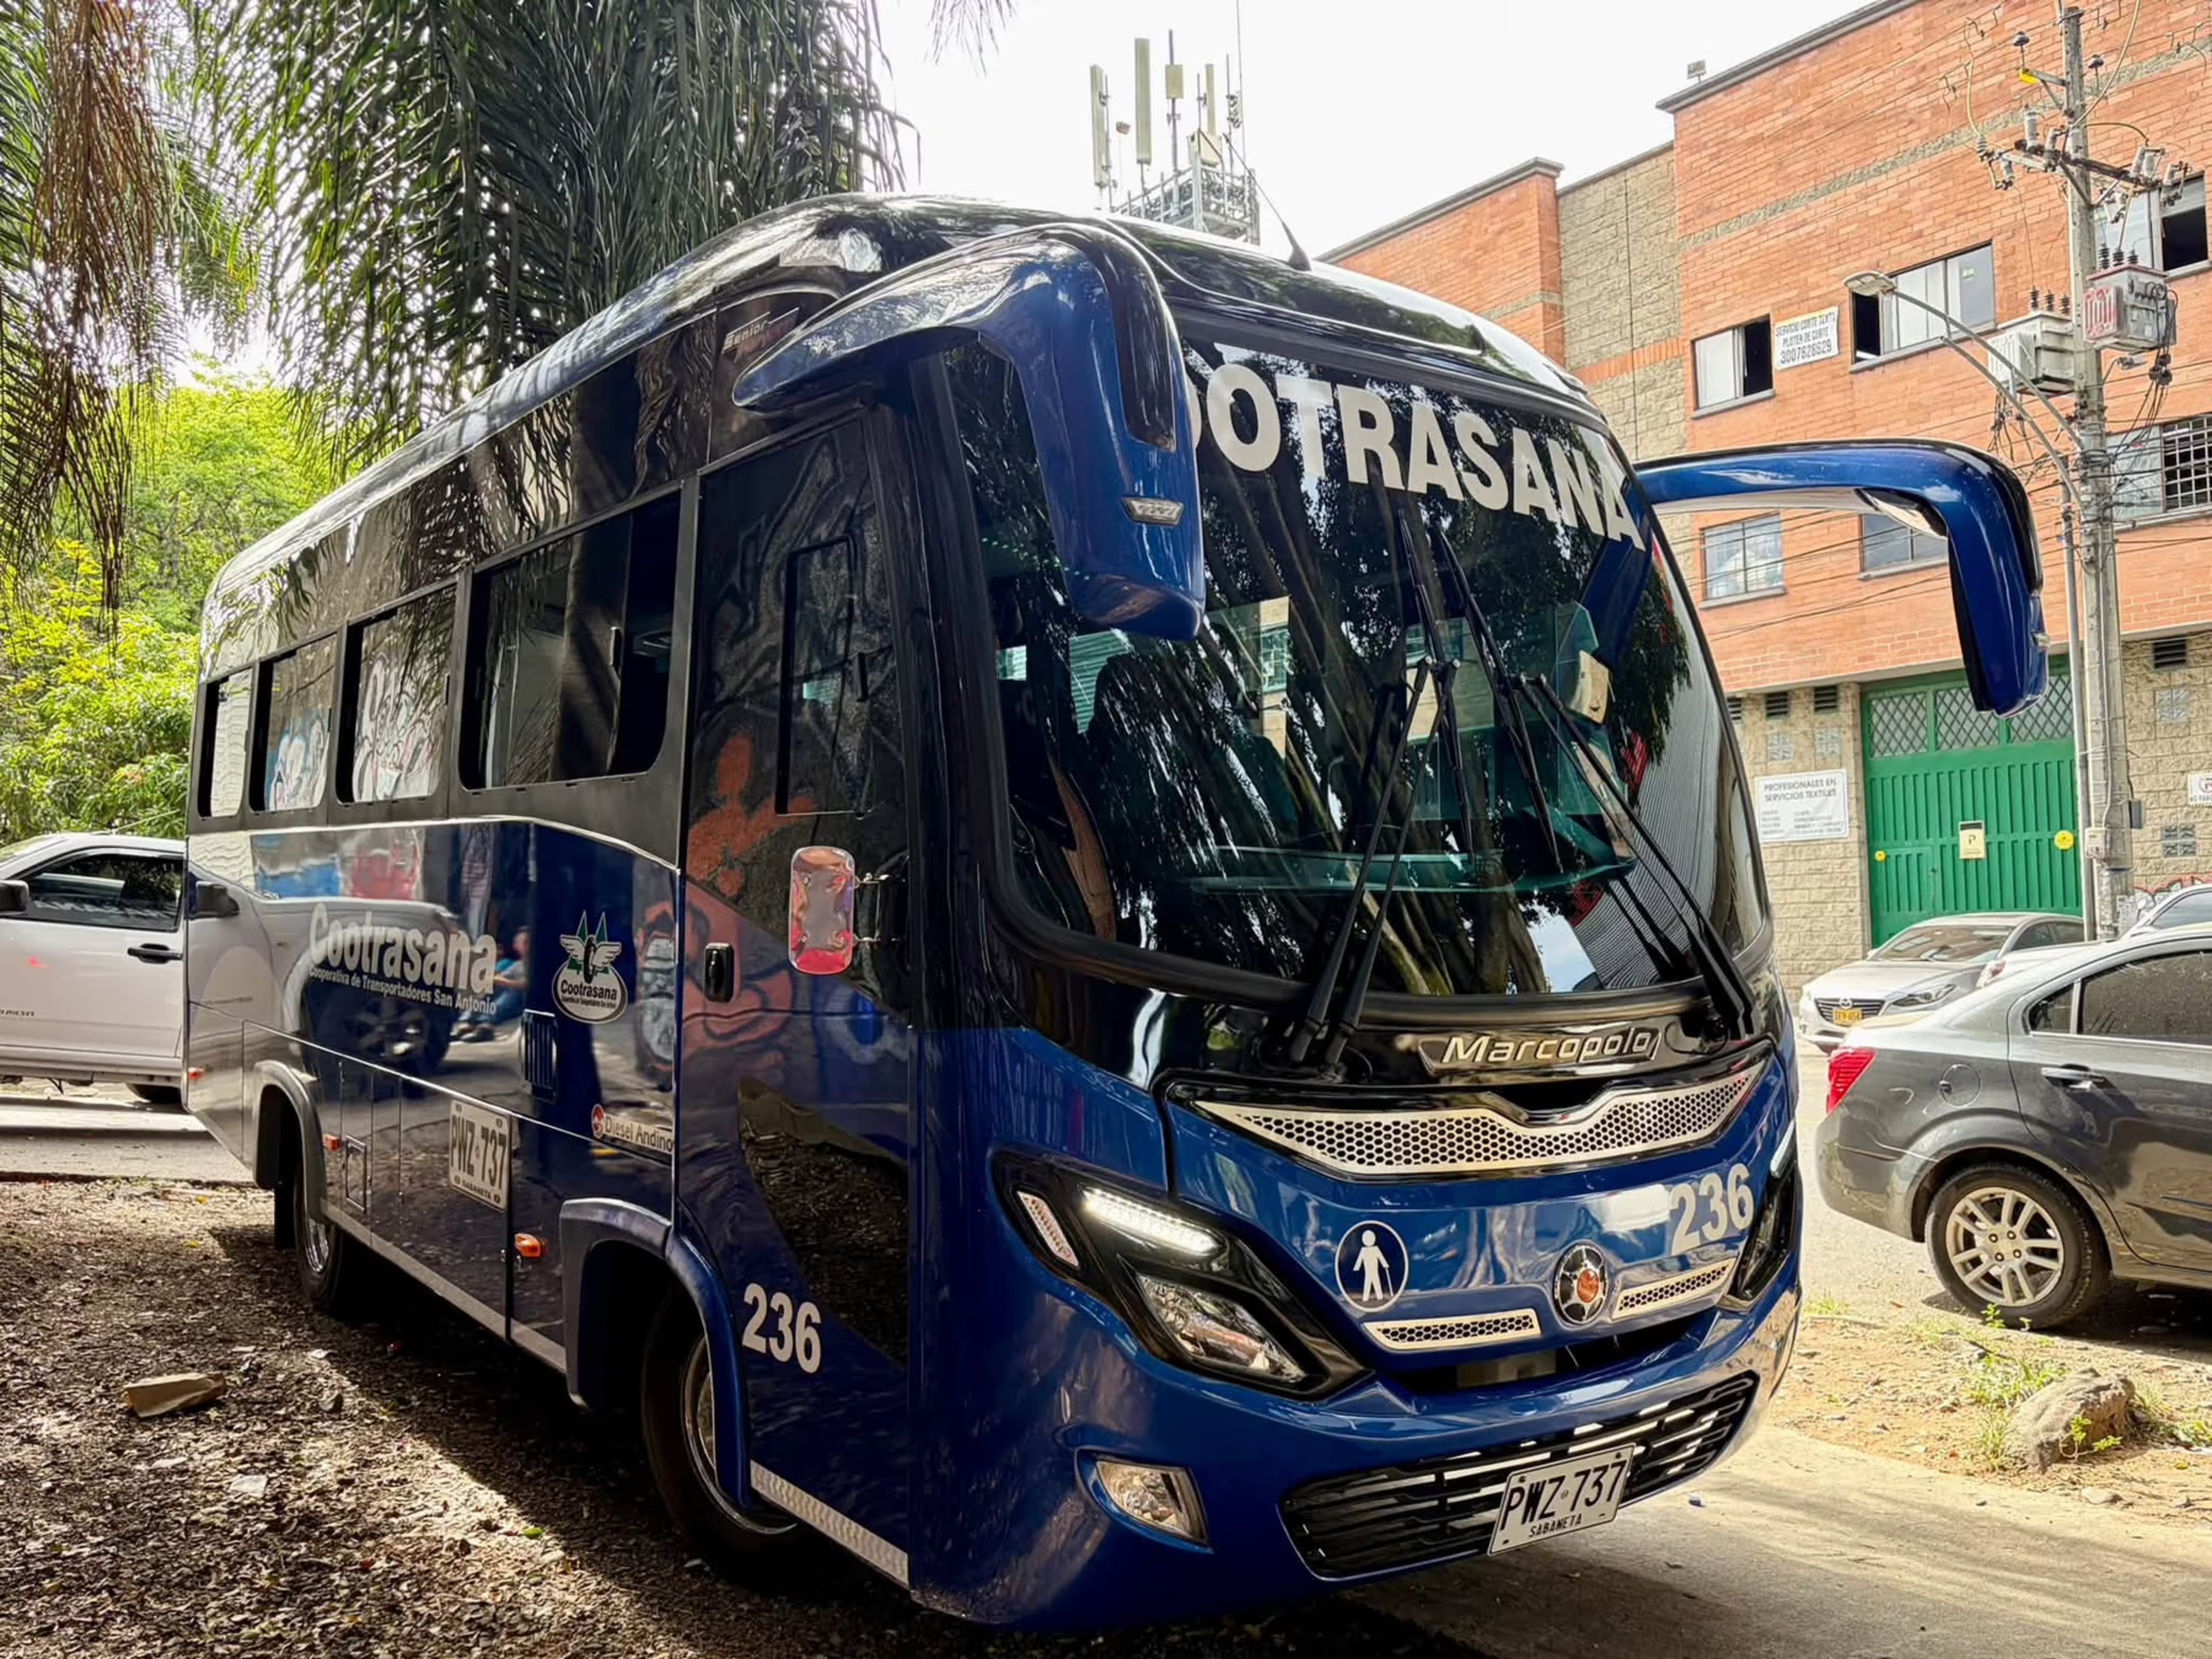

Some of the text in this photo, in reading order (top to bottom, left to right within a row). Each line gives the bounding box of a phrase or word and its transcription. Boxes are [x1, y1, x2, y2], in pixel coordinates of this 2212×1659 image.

[1187, 363, 1646, 551] OTRASANA
[1764, 778, 1836, 791] PROFESIONALES EN
[1765, 792, 1804, 802] SERVICIOS
[310, 903, 497, 994] Cootrasana
[351, 972, 361, 987] de
[362, 974, 431, 1003] Transportadores
[433, 988, 453, 1007] San
[454, 993, 496, 1015] Antonio
[561, 979, 617, 1001] Cootrasana
[1442, 1027, 1652, 1064] Marcopolo
[605, 1115, 632, 1141] Diesel
[1669, 1163, 1754, 1256] 236
[742, 1282, 821, 1374] 236
[1529, 1513, 1583, 1538] SABANETA
